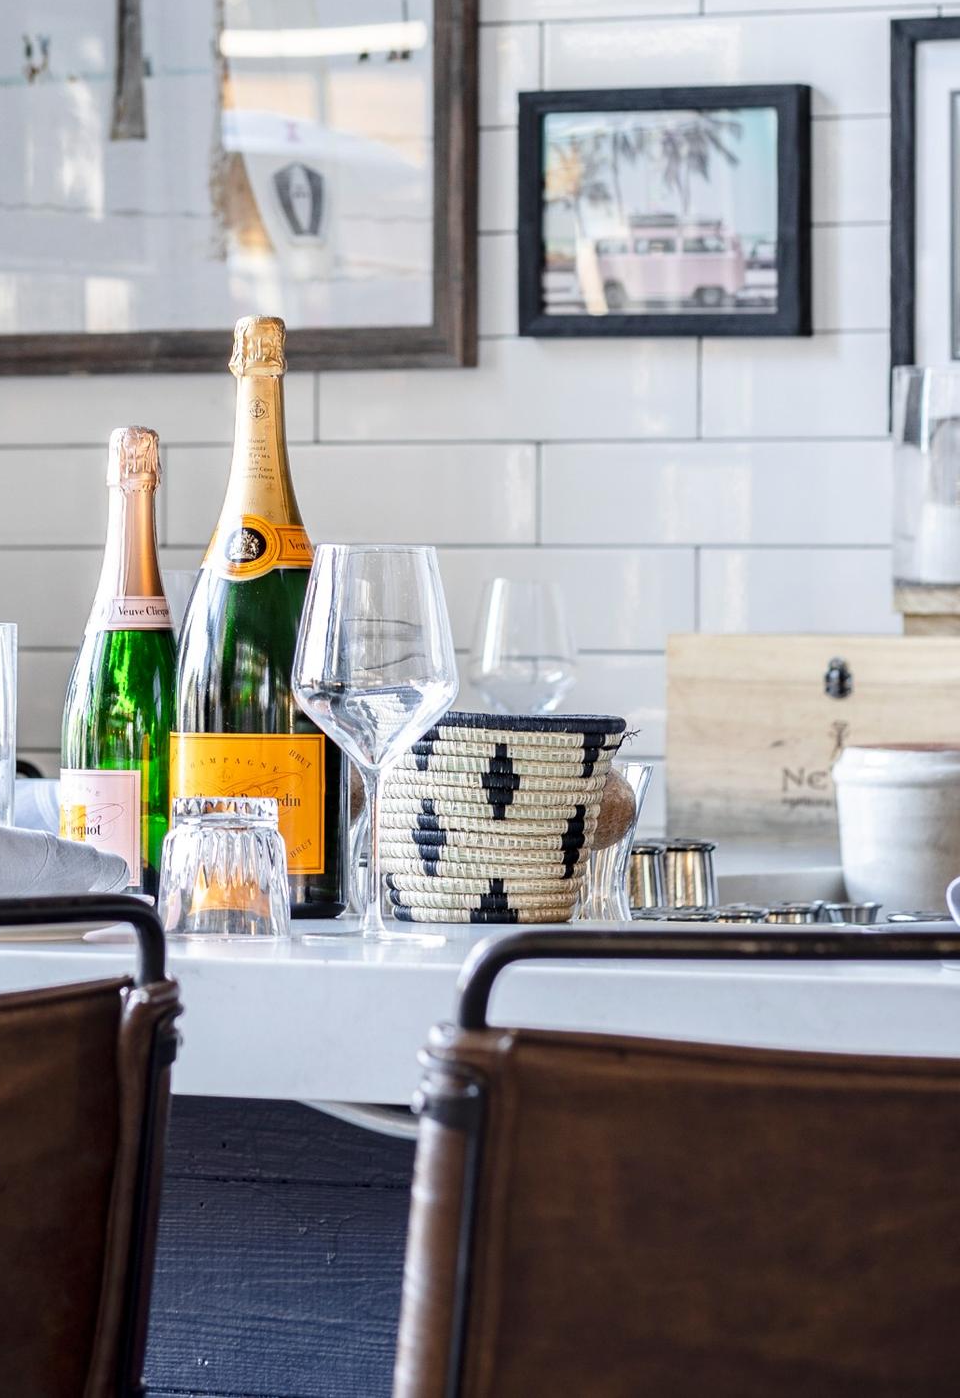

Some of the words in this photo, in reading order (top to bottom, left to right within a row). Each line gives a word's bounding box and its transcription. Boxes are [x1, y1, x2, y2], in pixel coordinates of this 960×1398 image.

[118, 606, 145, 616] Veuve
[288, 749, 313, 770] BRUT
[289, 838, 313, 859] BRUT
